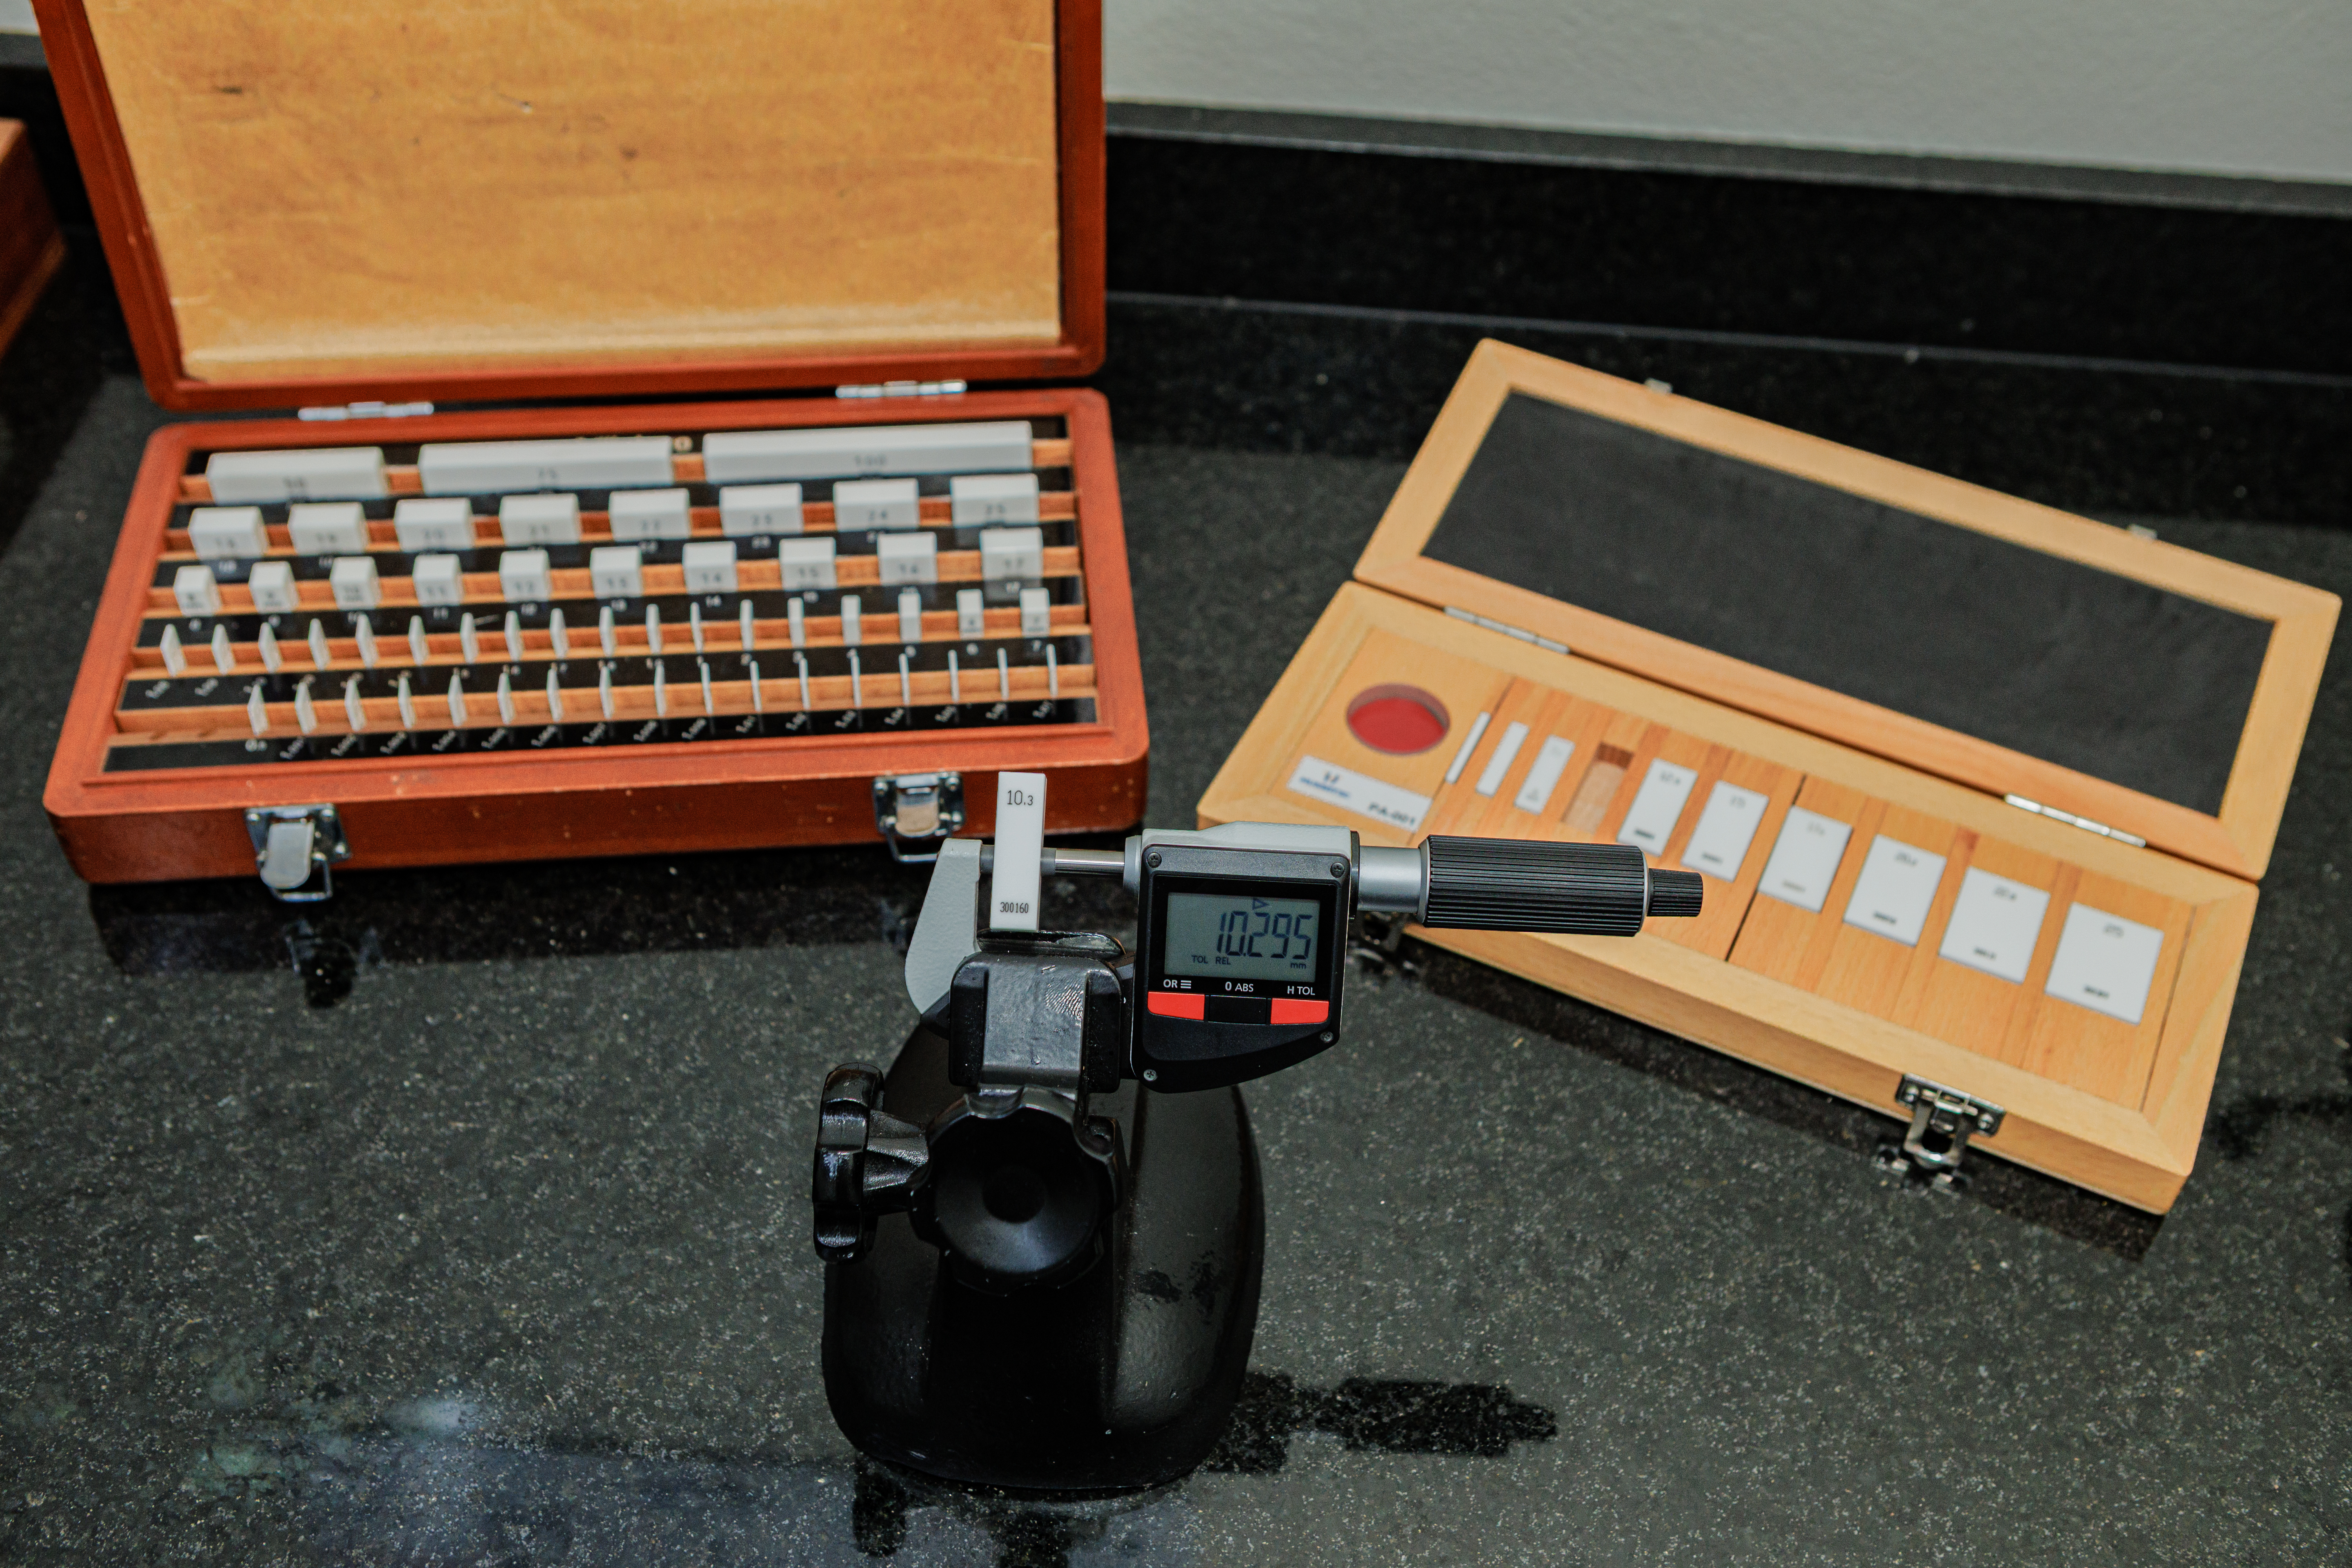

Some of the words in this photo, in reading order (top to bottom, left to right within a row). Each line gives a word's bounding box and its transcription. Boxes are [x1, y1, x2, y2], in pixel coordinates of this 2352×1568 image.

[1007, 790, 1033, 806] 10.3
[1000, 902, 1029, 913] 300160
[1217, 911, 1313, 960] 10.295
[1191, 955, 1208, 964] TOL
[1215, 956, 1231, 965] REL
[1163, 979, 1178, 989] OR
[1225, 982, 1232, 991] 0
[1235, 983, 1254, 992] ABS
[1287, 985, 1294, 995] H
[1297, 986, 1316, 995] TOL
